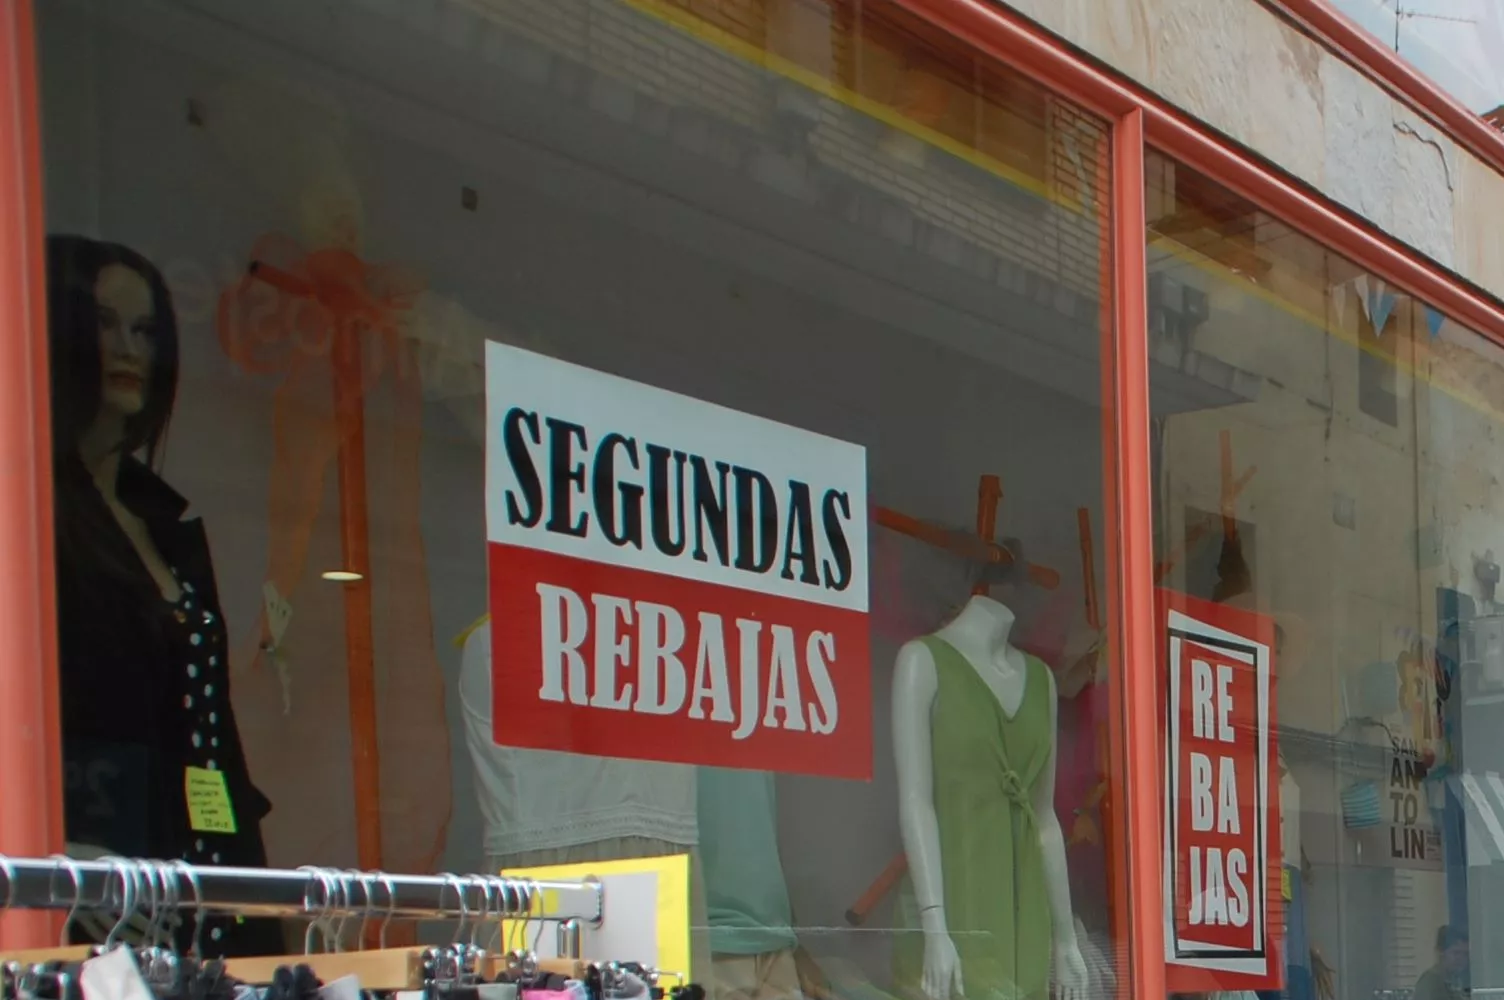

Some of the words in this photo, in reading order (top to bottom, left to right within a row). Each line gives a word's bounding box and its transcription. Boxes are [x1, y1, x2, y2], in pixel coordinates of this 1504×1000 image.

[503, 407, 852, 592] SEGUNDAS
[536, 582, 839, 740] REBAJAS
[1190, 659, 1235, 744] RE
[1190, 752, 1241, 835] BA
[1390, 791, 1418, 826] TO
[1390, 826, 1425, 860] LIN
[1188, 846, 1249, 927] JAS
